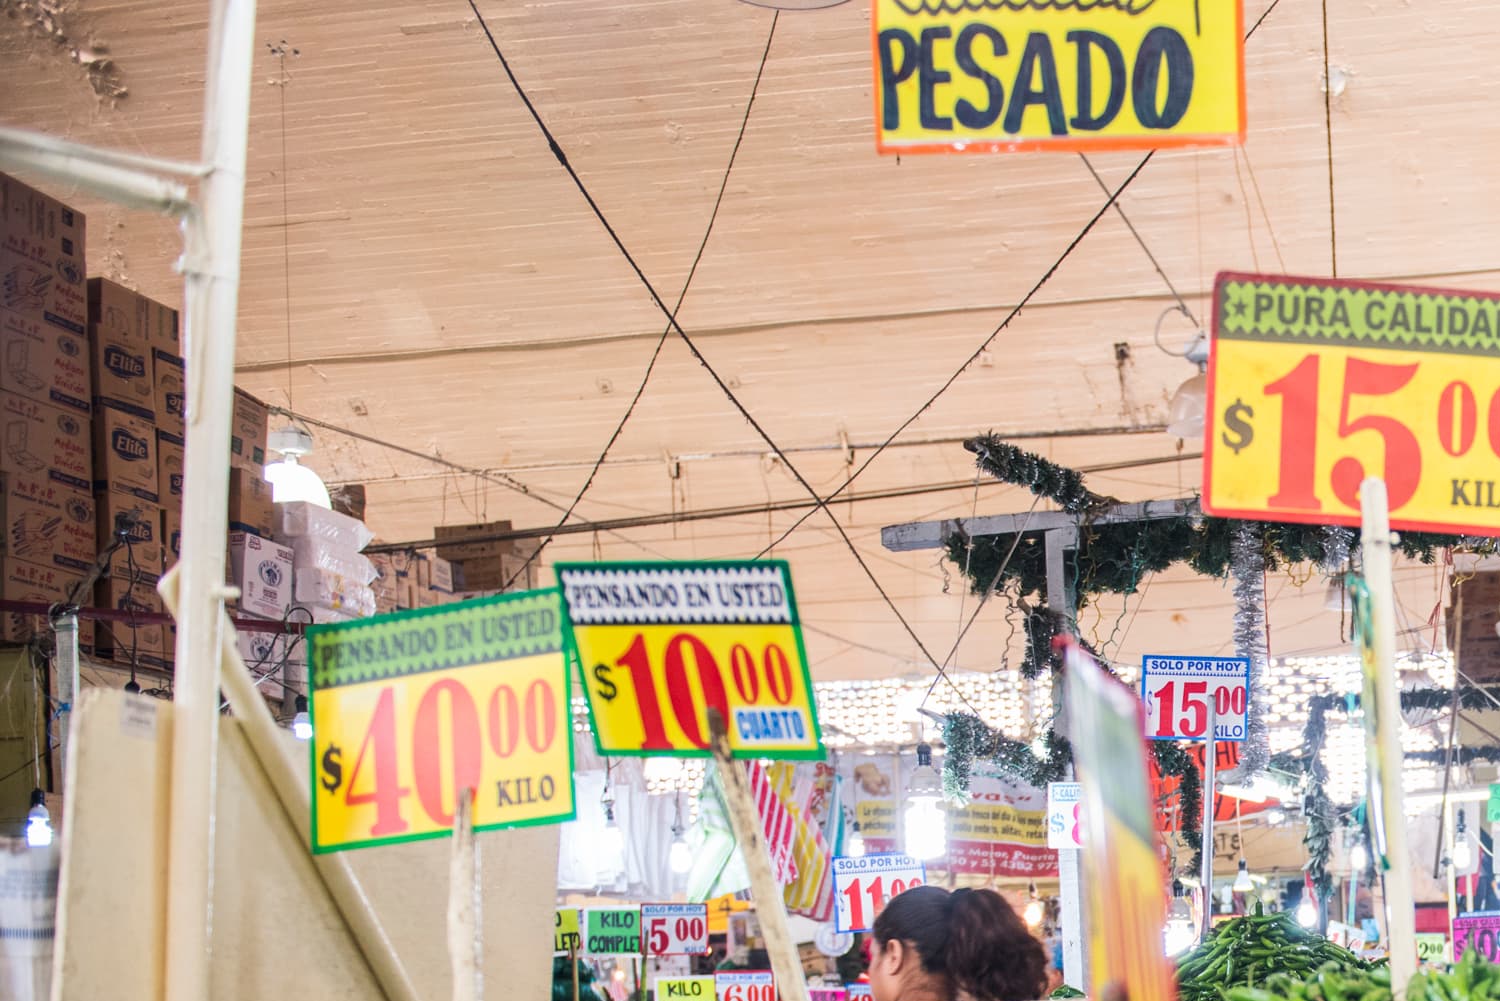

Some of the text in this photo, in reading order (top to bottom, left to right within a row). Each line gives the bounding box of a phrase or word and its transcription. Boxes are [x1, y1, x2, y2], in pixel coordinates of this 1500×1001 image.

[877, 22, 1195, 136] PESADO
[1253, 293, 1350, 328] PURA
[109, 353, 144, 376] Elite
[116, 436, 147, 457] Elite
[572, 576, 783, 610] PENSANDO EN USTED
[320, 609, 555, 672] PENSANDO EN USTED
[1151, 660, 1242, 672] SOLO POR HOY
[735, 709, 806, 741] CUARTO
[496, 775, 555, 808] KILO
[838, 856, 917, 869] SOLO POR HOY
[601, 912, 635, 929] KILO
[645, 906, 664, 914] SOLO
[686, 905, 704, 913] HOY
[555, 931, 580, 951] LETO
[667, 982, 702, 997] KILO
